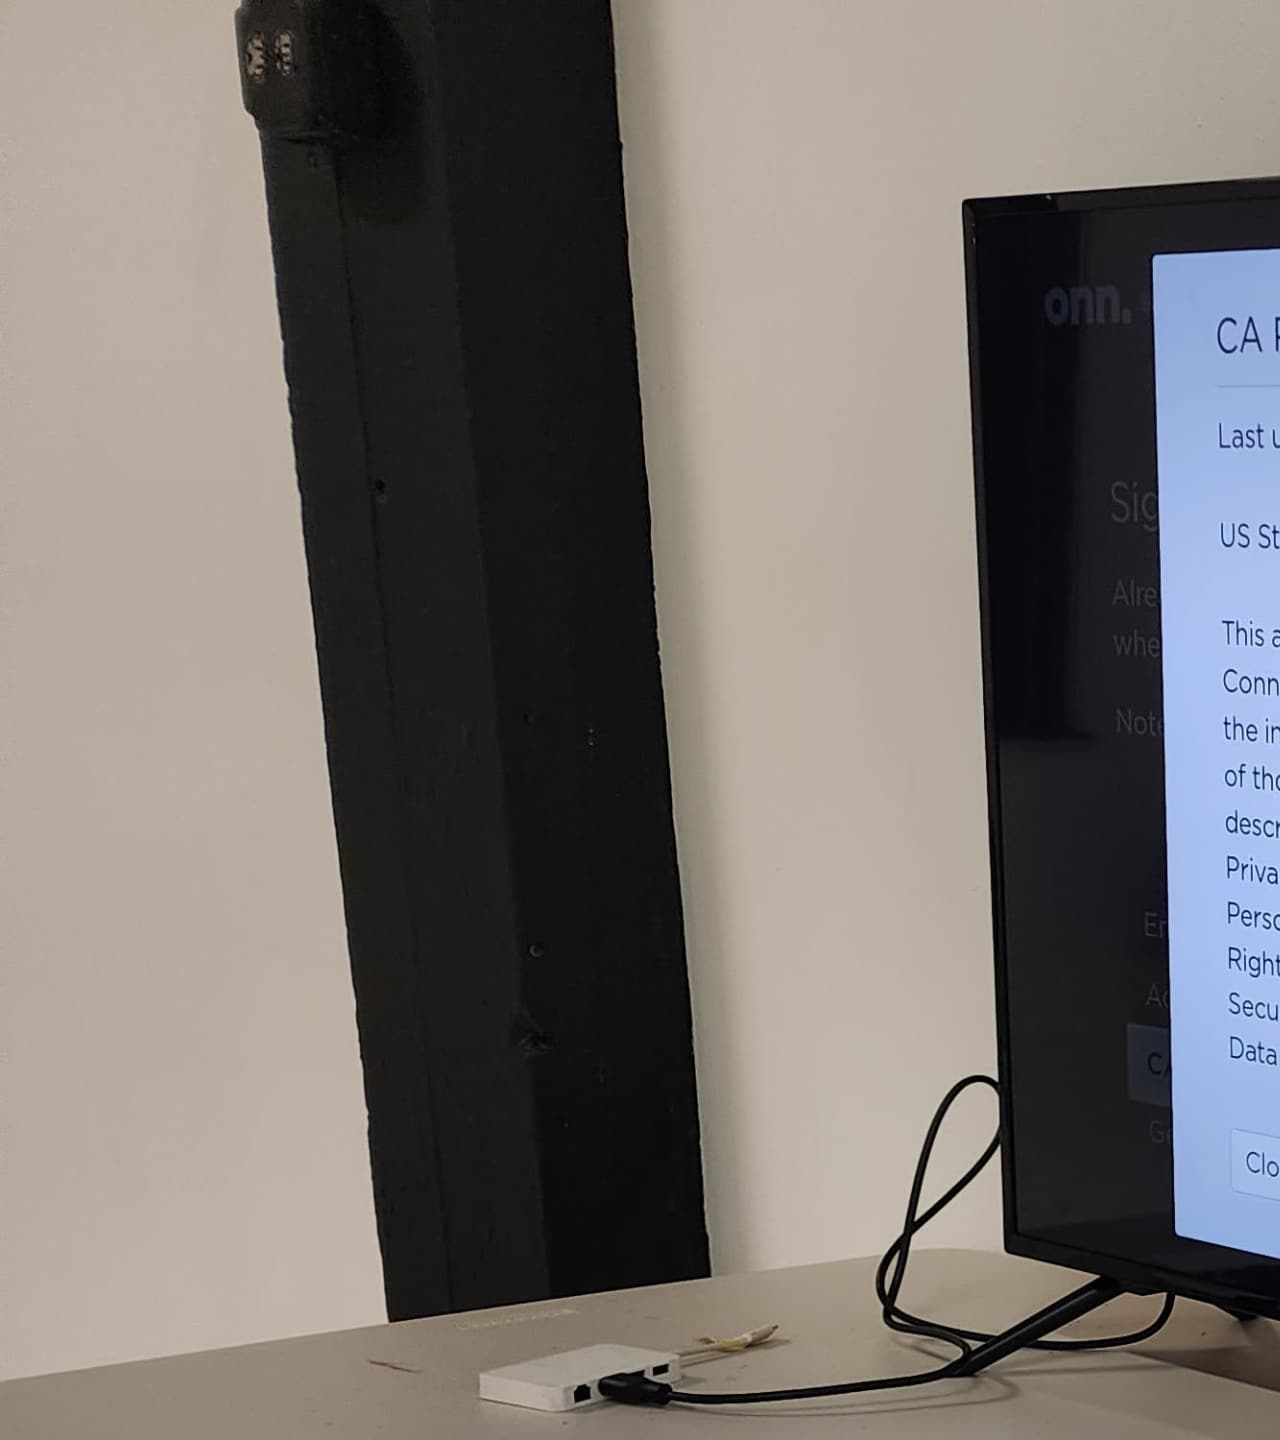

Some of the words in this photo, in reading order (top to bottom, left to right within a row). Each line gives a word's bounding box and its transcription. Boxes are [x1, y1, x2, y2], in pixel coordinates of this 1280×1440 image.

[1215, 314, 1263, 354] CA
[1217, 421, 1265, 449] Last
[1219, 521, 1251, 549] US
[1220, 618, 1265, 647] This
[1222, 714, 1258, 742] the
[1223, 762, 1247, 789] of
[1228, 1034, 1278, 1067] Data
